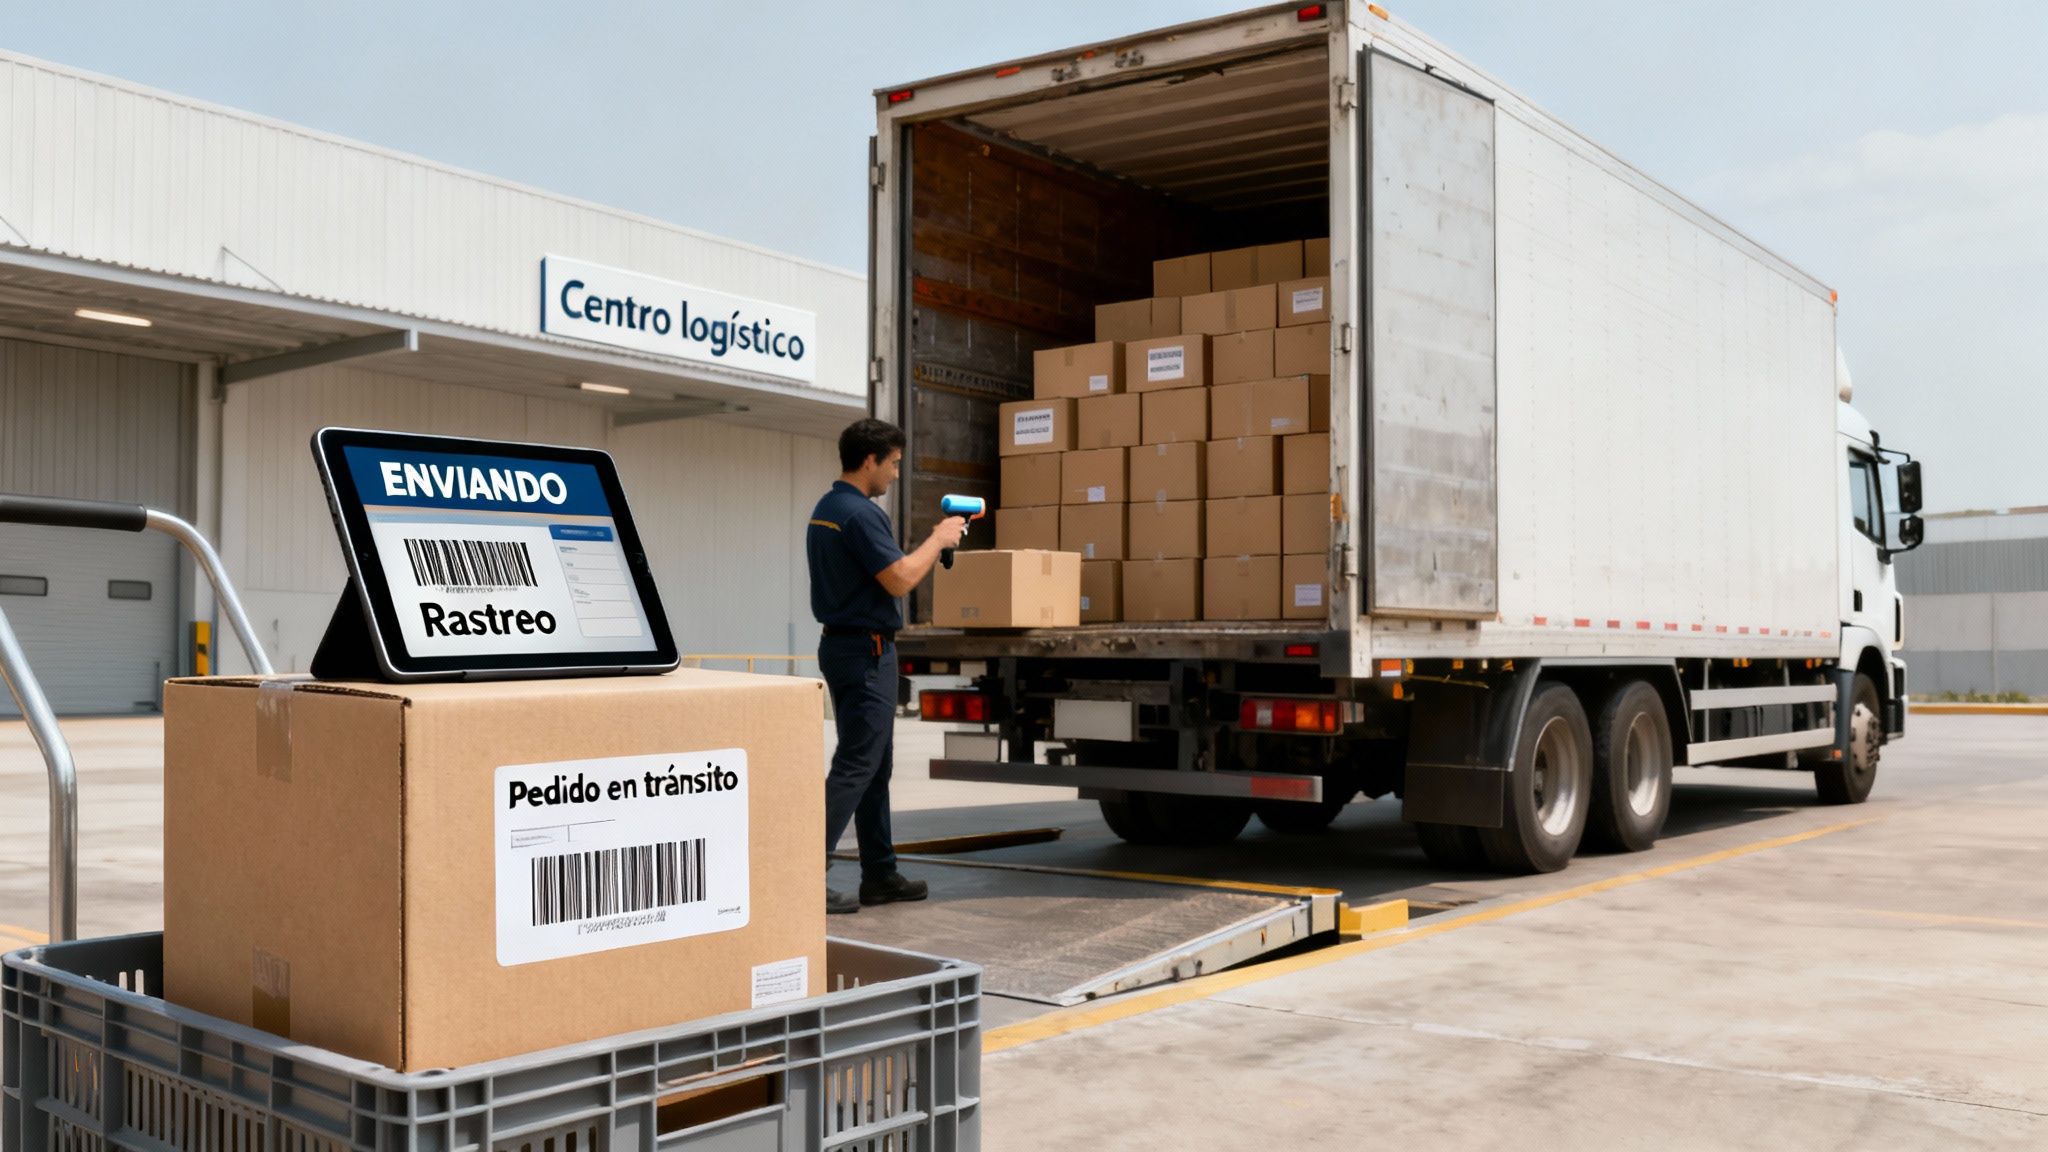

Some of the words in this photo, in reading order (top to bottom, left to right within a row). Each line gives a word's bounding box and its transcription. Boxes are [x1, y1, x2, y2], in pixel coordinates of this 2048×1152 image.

[560, 279, 672, 336] Centro
[681, 300, 806, 361] logístico
[379, 461, 568, 505] ENVIANDO
[419, 602, 557, 638] Rastreo
[509, 772, 601, 809] Pedido
[606, 778, 638, 801] en
[643, 761, 739, 798] tránsito
